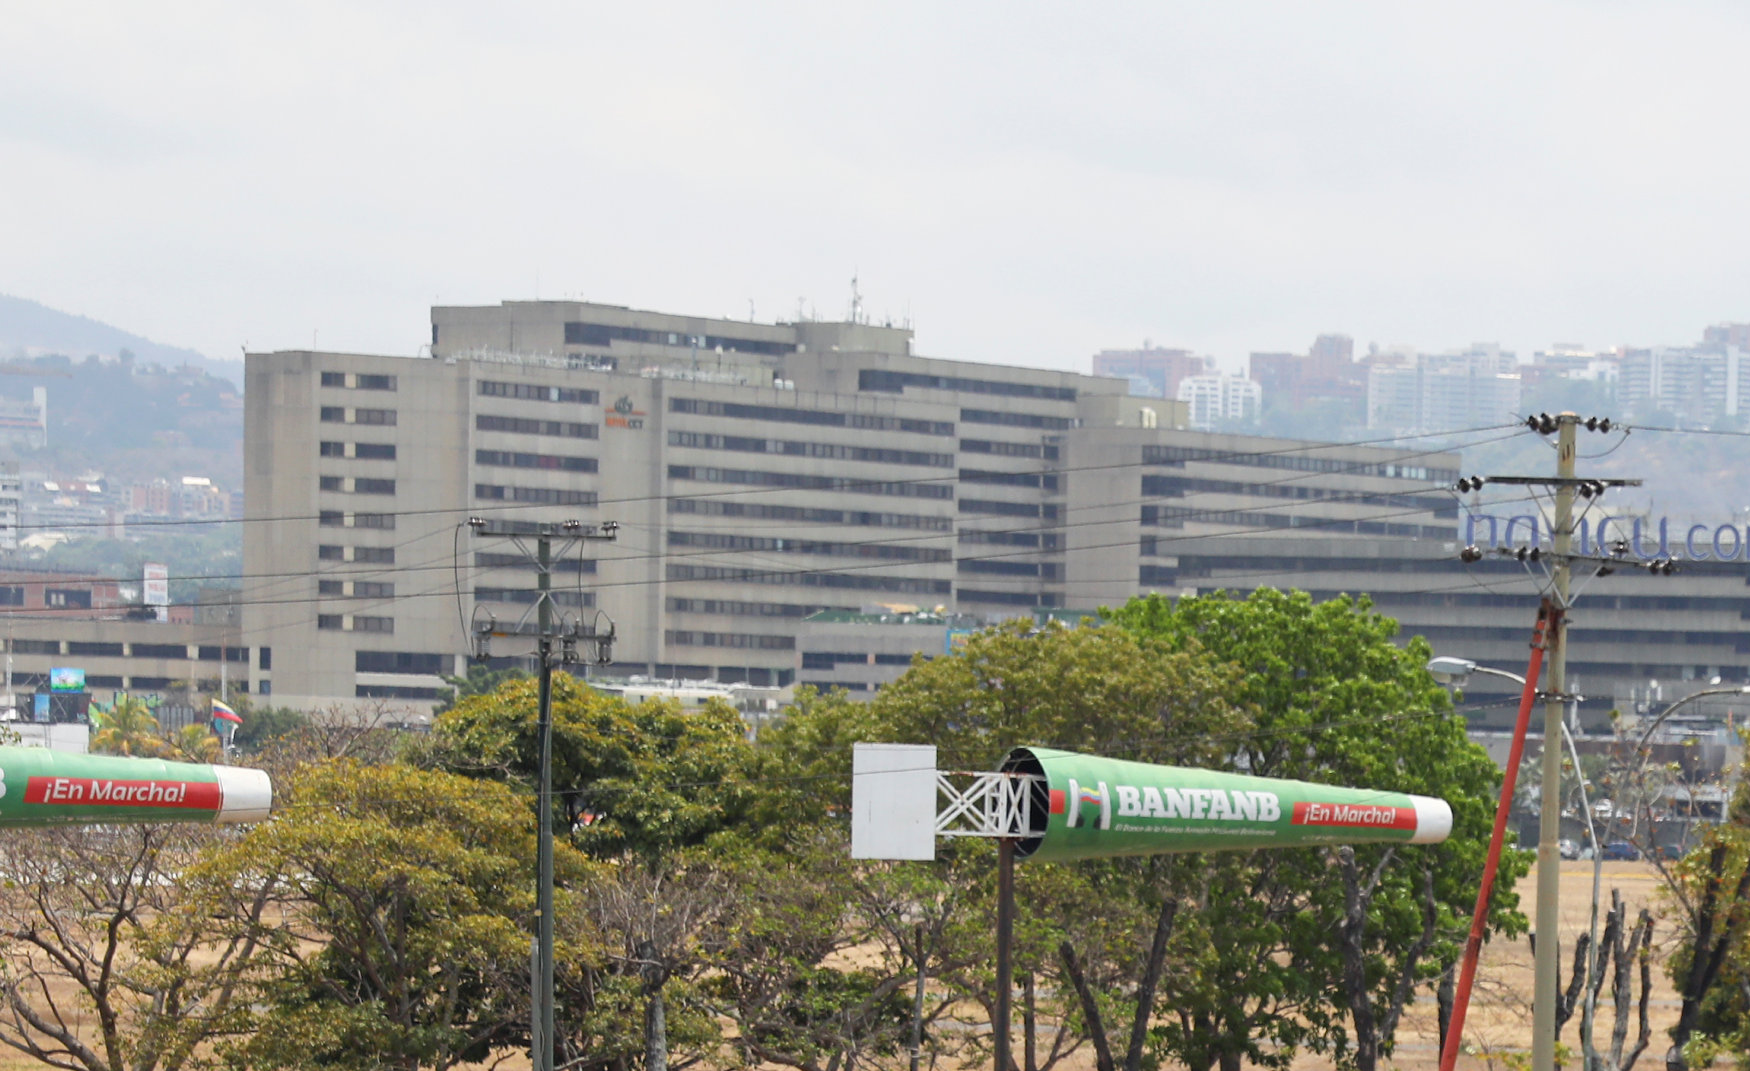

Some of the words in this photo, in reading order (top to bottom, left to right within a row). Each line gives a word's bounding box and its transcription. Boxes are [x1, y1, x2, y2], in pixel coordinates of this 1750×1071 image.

[43, 778, 84, 803] ¡En
[89, 780, 188, 803] Marcha!
[1115, 785, 1282, 822] BANFANB
[1303, 803, 1330, 825] ¡En
[1333, 805, 1396, 824] Marcha!
